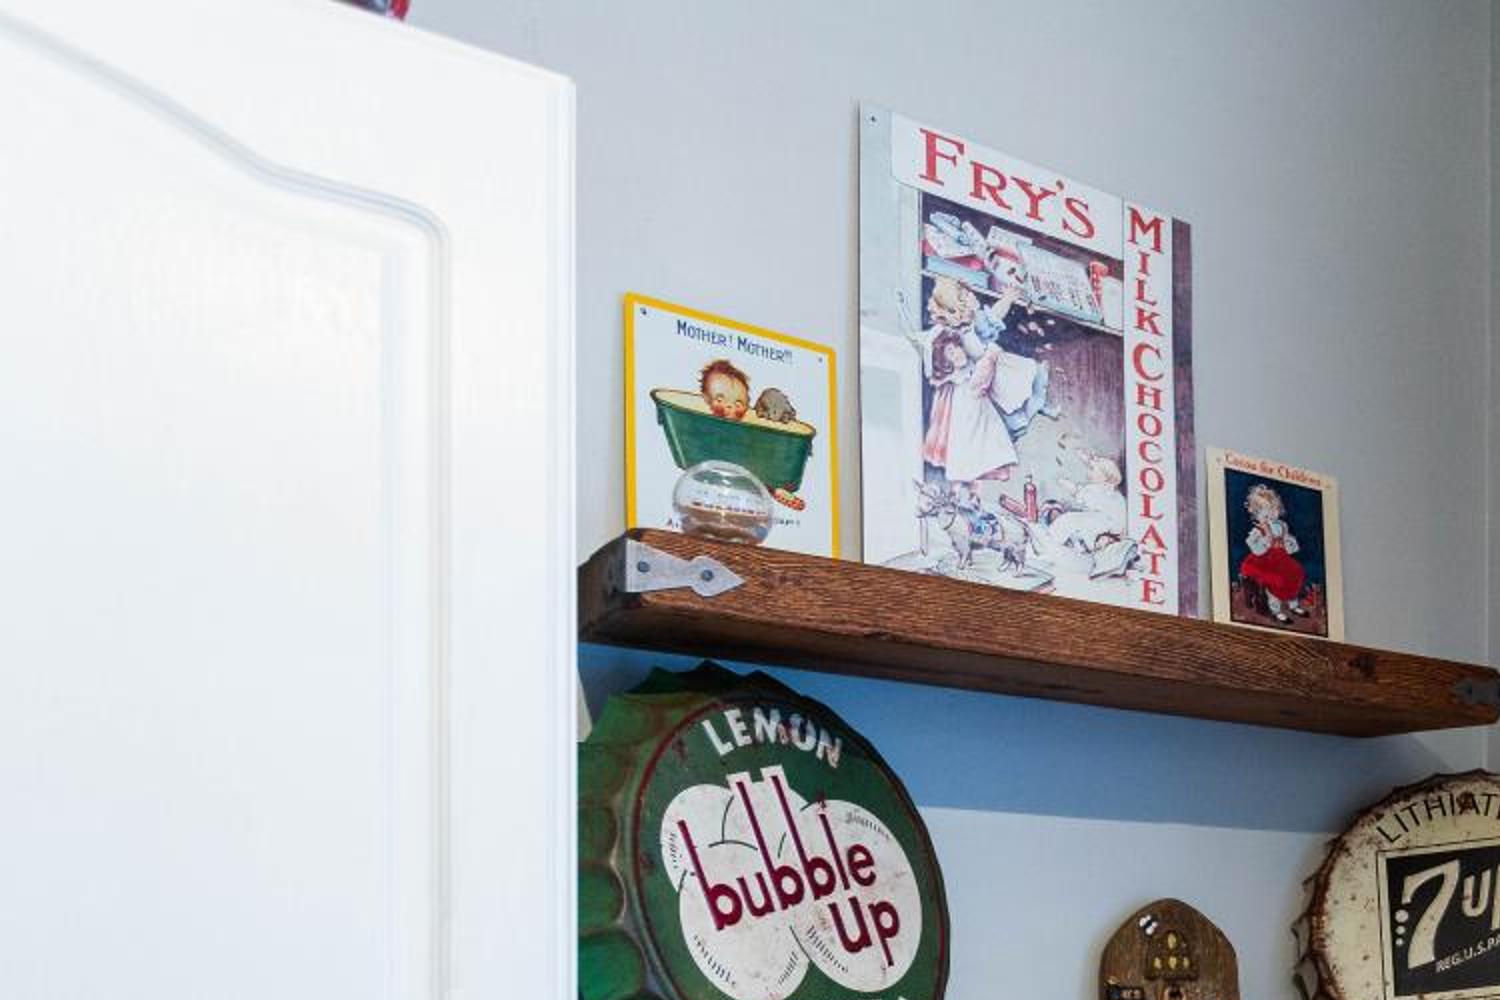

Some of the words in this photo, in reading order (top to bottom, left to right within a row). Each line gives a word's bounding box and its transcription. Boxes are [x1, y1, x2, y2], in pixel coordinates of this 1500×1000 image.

[919, 128, 1095, 239] FRY'S
[1127, 206, 1166, 337] MILK
[1131, 343, 1167, 606] CHOCOLATE
[701, 707, 842, 768] LEMON
[677, 775, 877, 931] bubble
